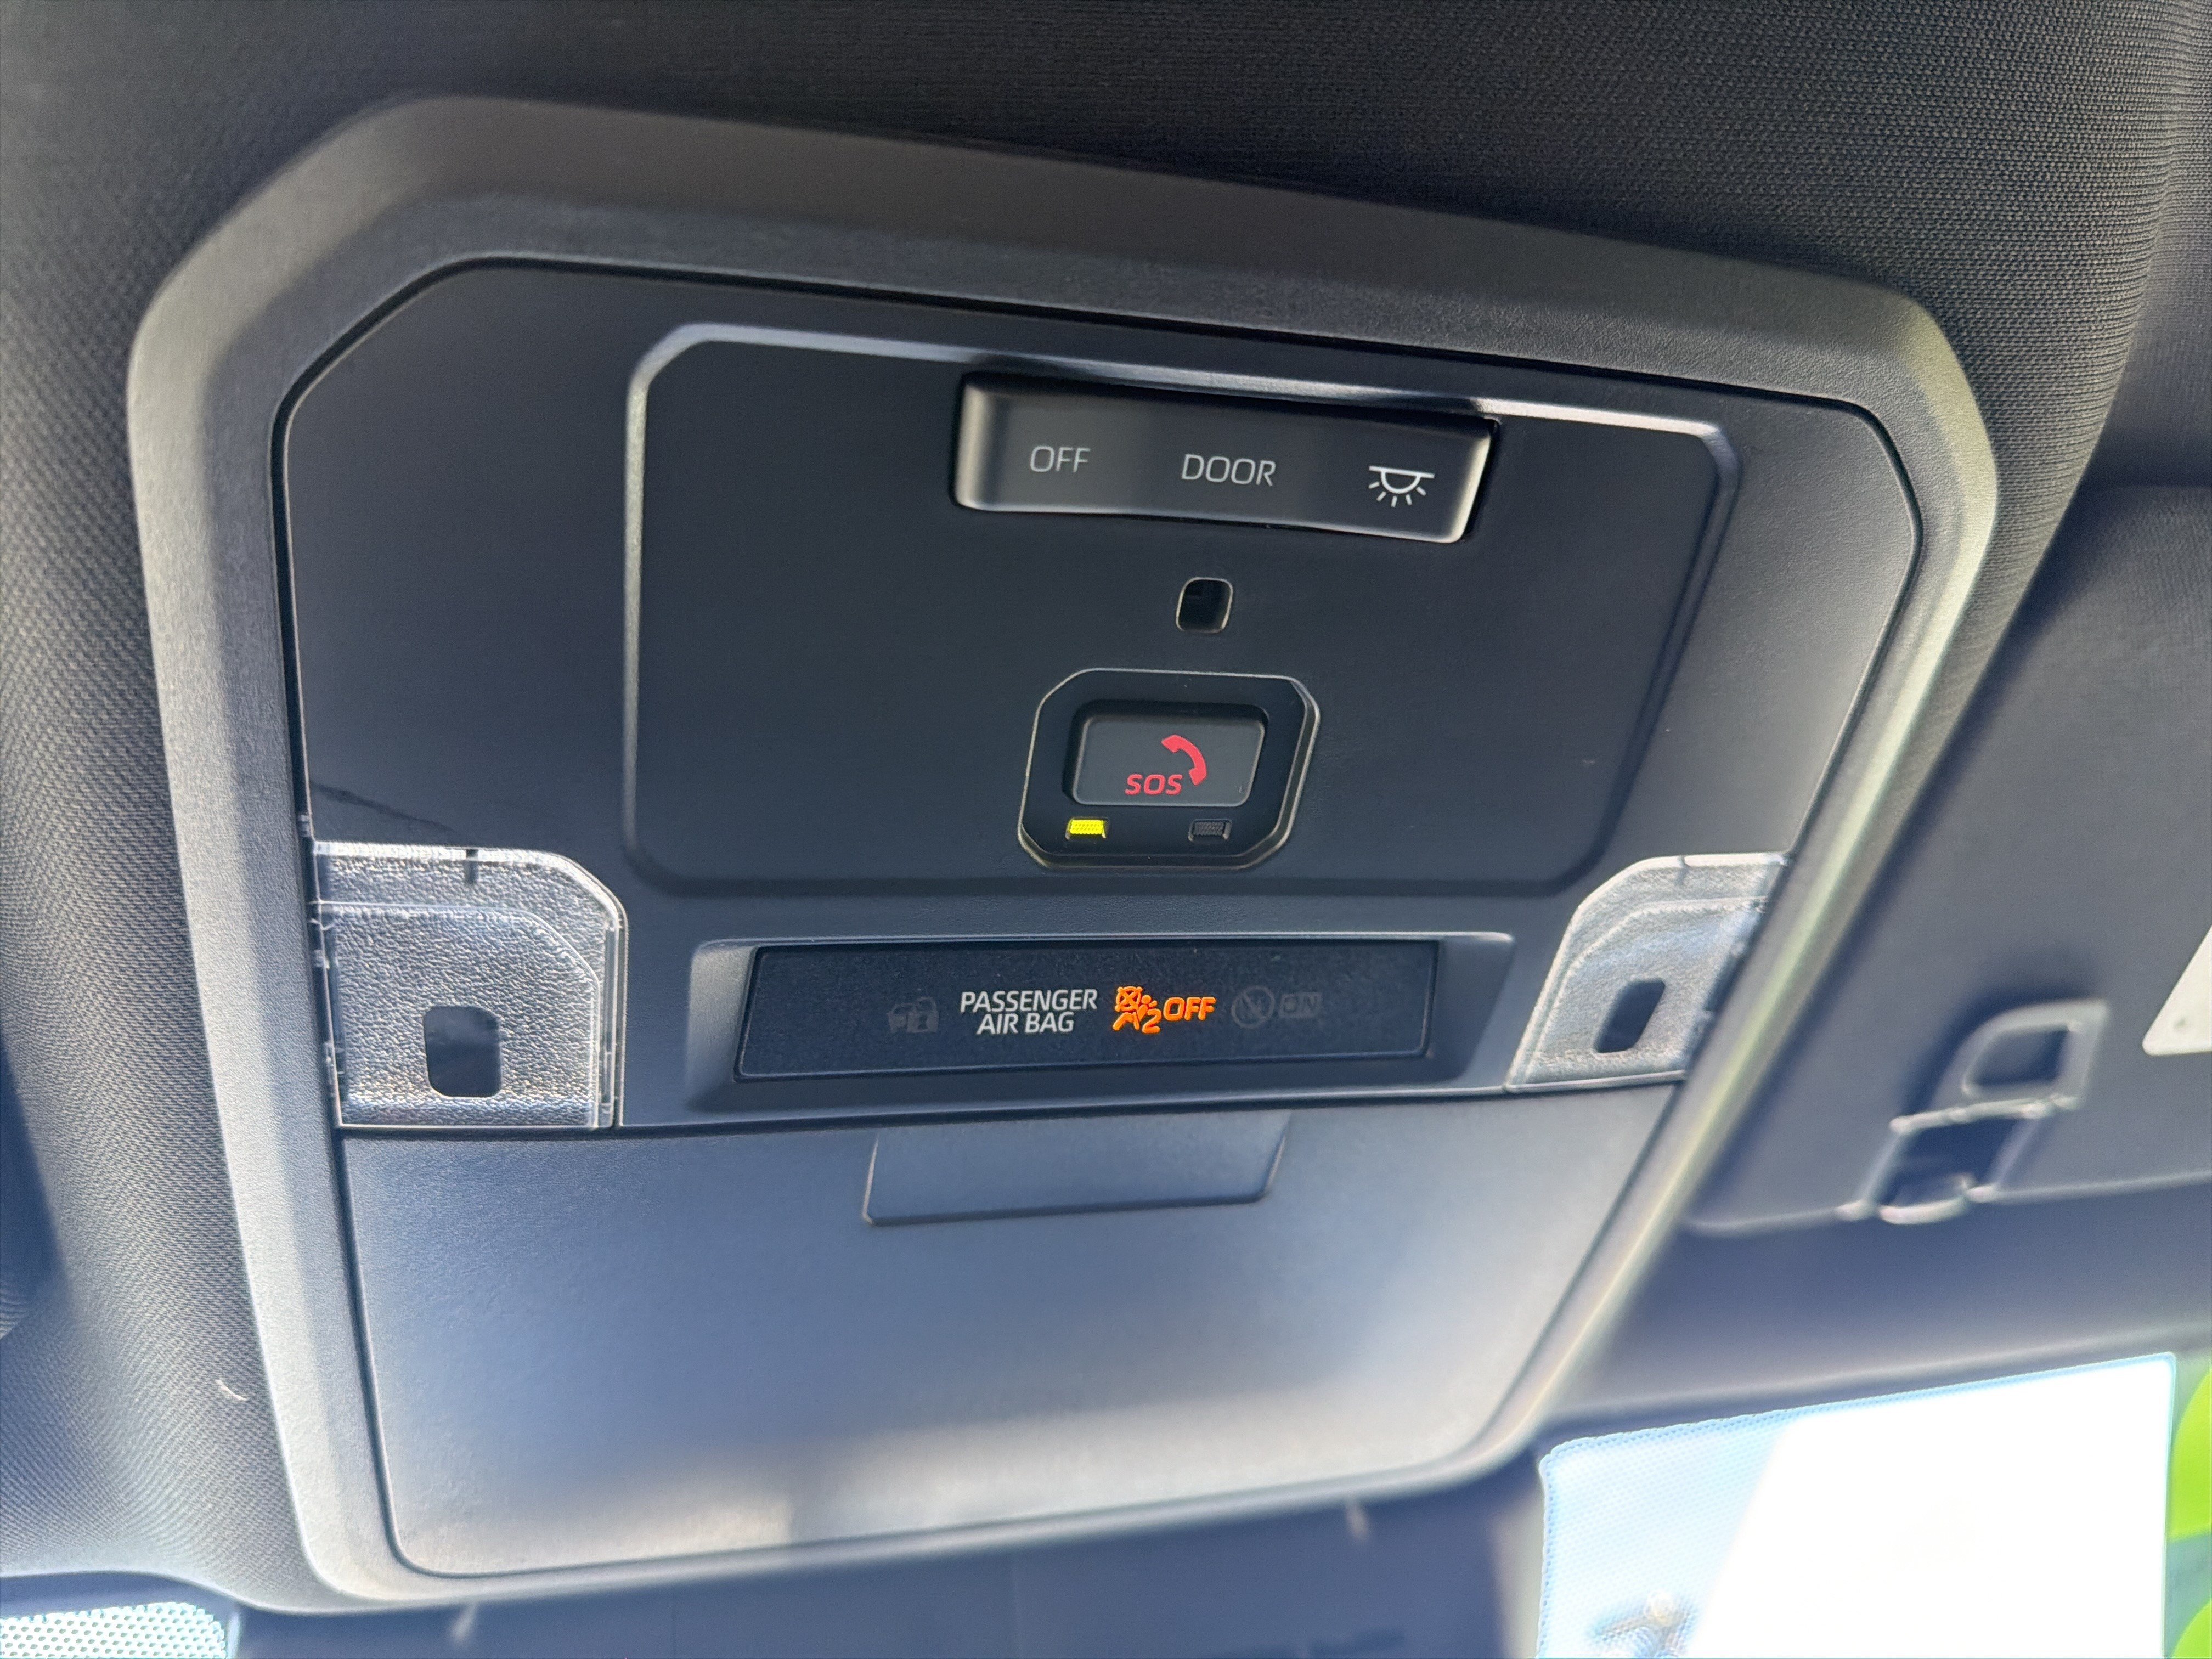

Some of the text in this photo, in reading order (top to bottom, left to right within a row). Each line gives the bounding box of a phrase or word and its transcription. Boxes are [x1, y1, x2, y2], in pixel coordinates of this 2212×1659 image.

[1029, 446, 1090, 473] OFF
[1180, 453, 1277, 487] DOOR
[1125, 774, 1183, 795] SOS
[960, 989, 1098, 1013] PASSENGER
[1163, 997, 1216, 1021] OFF
[976, 1011, 1075, 1035] AIR BAG
